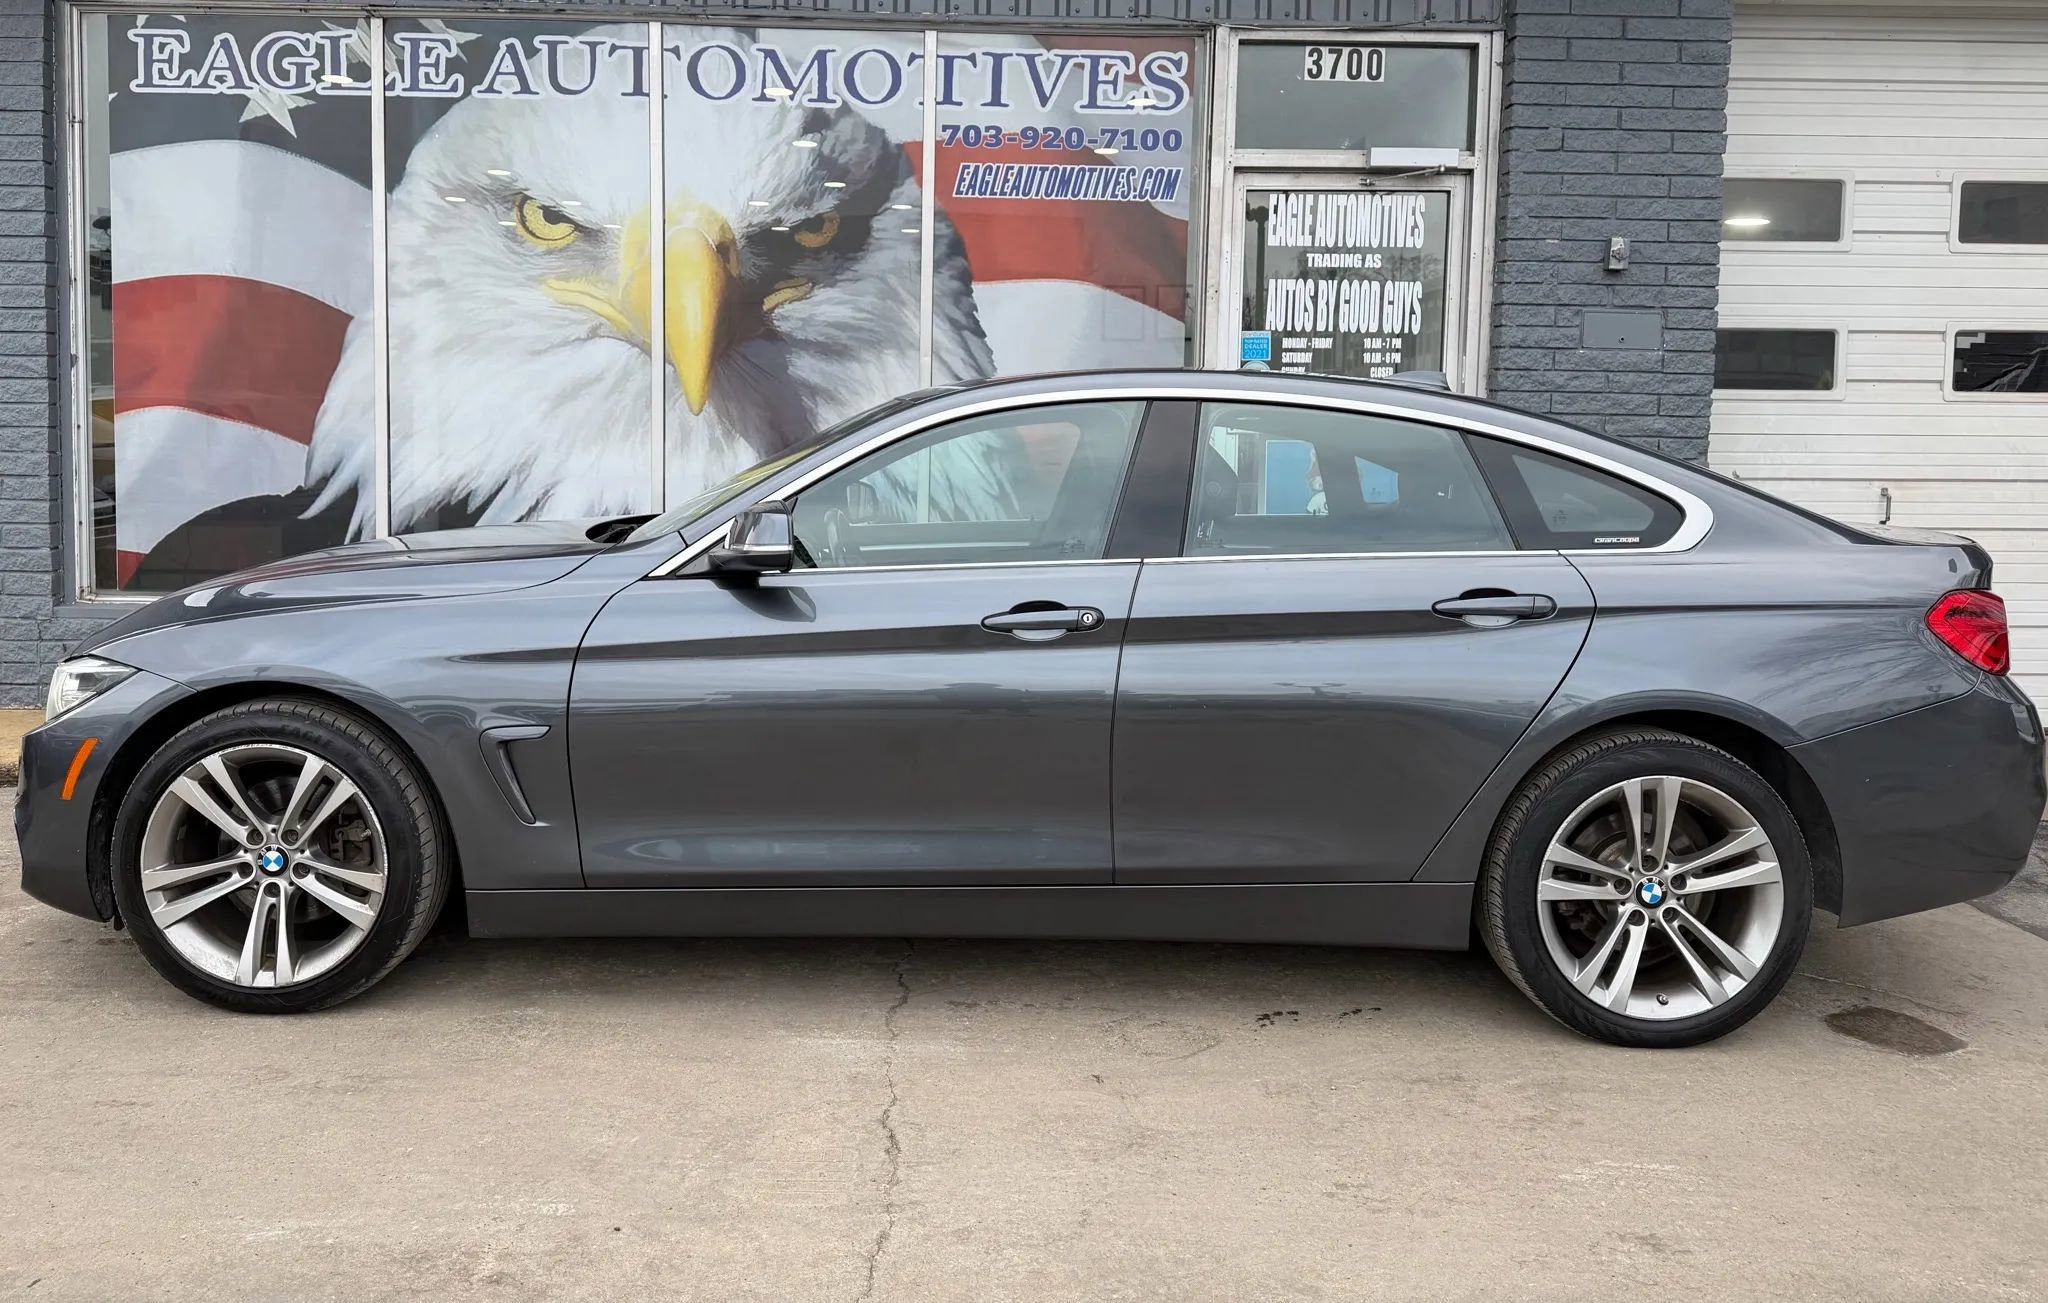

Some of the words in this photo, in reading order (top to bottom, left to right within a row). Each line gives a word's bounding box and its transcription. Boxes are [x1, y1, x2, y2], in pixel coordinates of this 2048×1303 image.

[129, 29, 463, 97] EAGLE
[474, 37, 1189, 114] AUTOMOTIVES
[1306, 47, 1383, 81] 3700
[941, 124, 1183, 152] 703-920-7100
[952, 163, 1182, 200] EAGLEAUTOMOTIVES.COM
[1267, 193, 1314, 247] EAGLE
[1314, 193, 1425, 248] AUTOMOTIVES
[1306, 253, 1362, 268] TRADING
[1364, 254, 1382, 268] AS
[1265, 278, 1315, 332] AUTOS
[1316, 279, 1338, 332] BY
[1338, 279, 1381, 333] GOOD
[1383, 280, 1423, 335] GUYS
[1282, 337, 1308, 349] MONDAY
[1311, 337, 1333, 349] FRIDAY
[1363, 337, 1371, 349] 10
[1371, 337, 1382, 349] AM
[1386, 337, 1391, 349] 7
[1391, 337, 1402, 349] PM
[1244, 350, 1267, 359] 2021
[1281, 352, 1313, 363] SATURDAY
[1363, 352, 1371, 364] 10
[1371, 352, 1382, 364] AM
[1385, 352, 1391, 364] 6
[1391, 352, 1401, 364] PM
[1370, 366, 1394, 378] CLOSED
